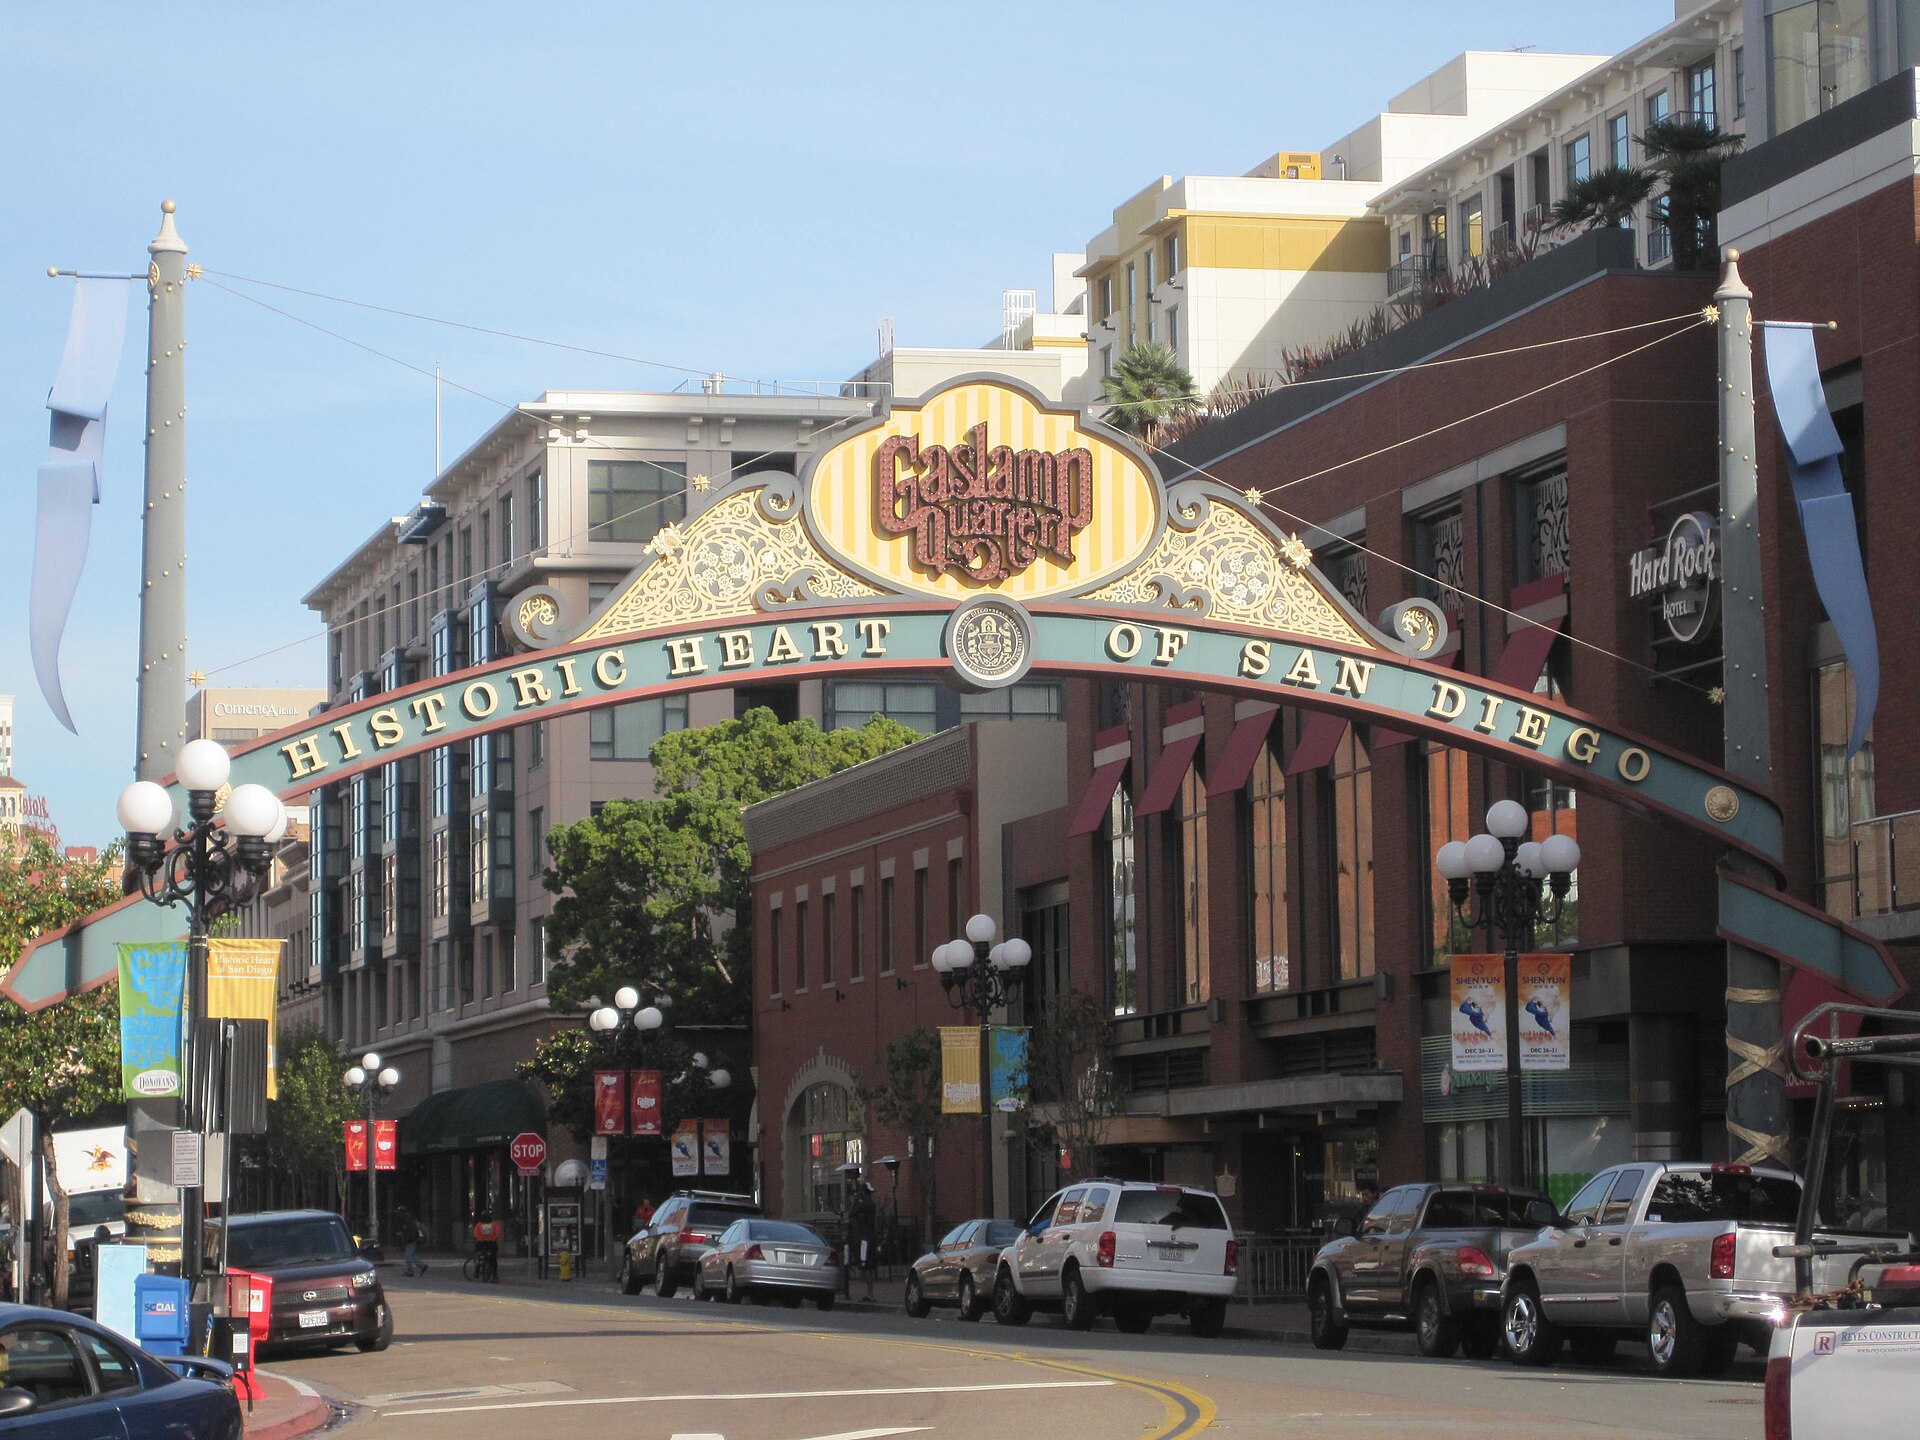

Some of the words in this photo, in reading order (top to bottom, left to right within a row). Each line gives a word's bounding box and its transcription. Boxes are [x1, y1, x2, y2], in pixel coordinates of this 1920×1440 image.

[880, 421, 1092, 532] Gaslamp
[916, 500, 1076, 581] Quarter
[1630, 540, 1670, 597] Hard
[1673, 528, 1715, 589] Rock
[1663, 600, 1688, 620] HOTEL
[282, 649, 627, 779] HISTORIC
[667, 619, 891, 675] HEART
[1109, 624, 1188, 662] OF
[1242, 640, 1376, 694] SAN
[1429, 680, 1650, 782] DIEGO
[278, 707, 299, 716] Bank
[214, 955, 249, 964] Historic
[251, 955, 275, 964] Heart
[216, 965, 225, 974] of
[227, 964, 245, 974] San
[246, 965, 273, 976] Diego
[1456, 976, 1480, 985] SHEN
[1481, 976, 1500, 985] YUN
[1522, 976, 1543, 985] SHEN
[1543, 976, 1566, 985] YUN
[513, 1144, 543, 1158] STOP
[144, 1302, 176, 1312] SOCIAL
[1841, 1331, 1868, 1341] REYES
[1819, 1336, 1830, 1350] R
